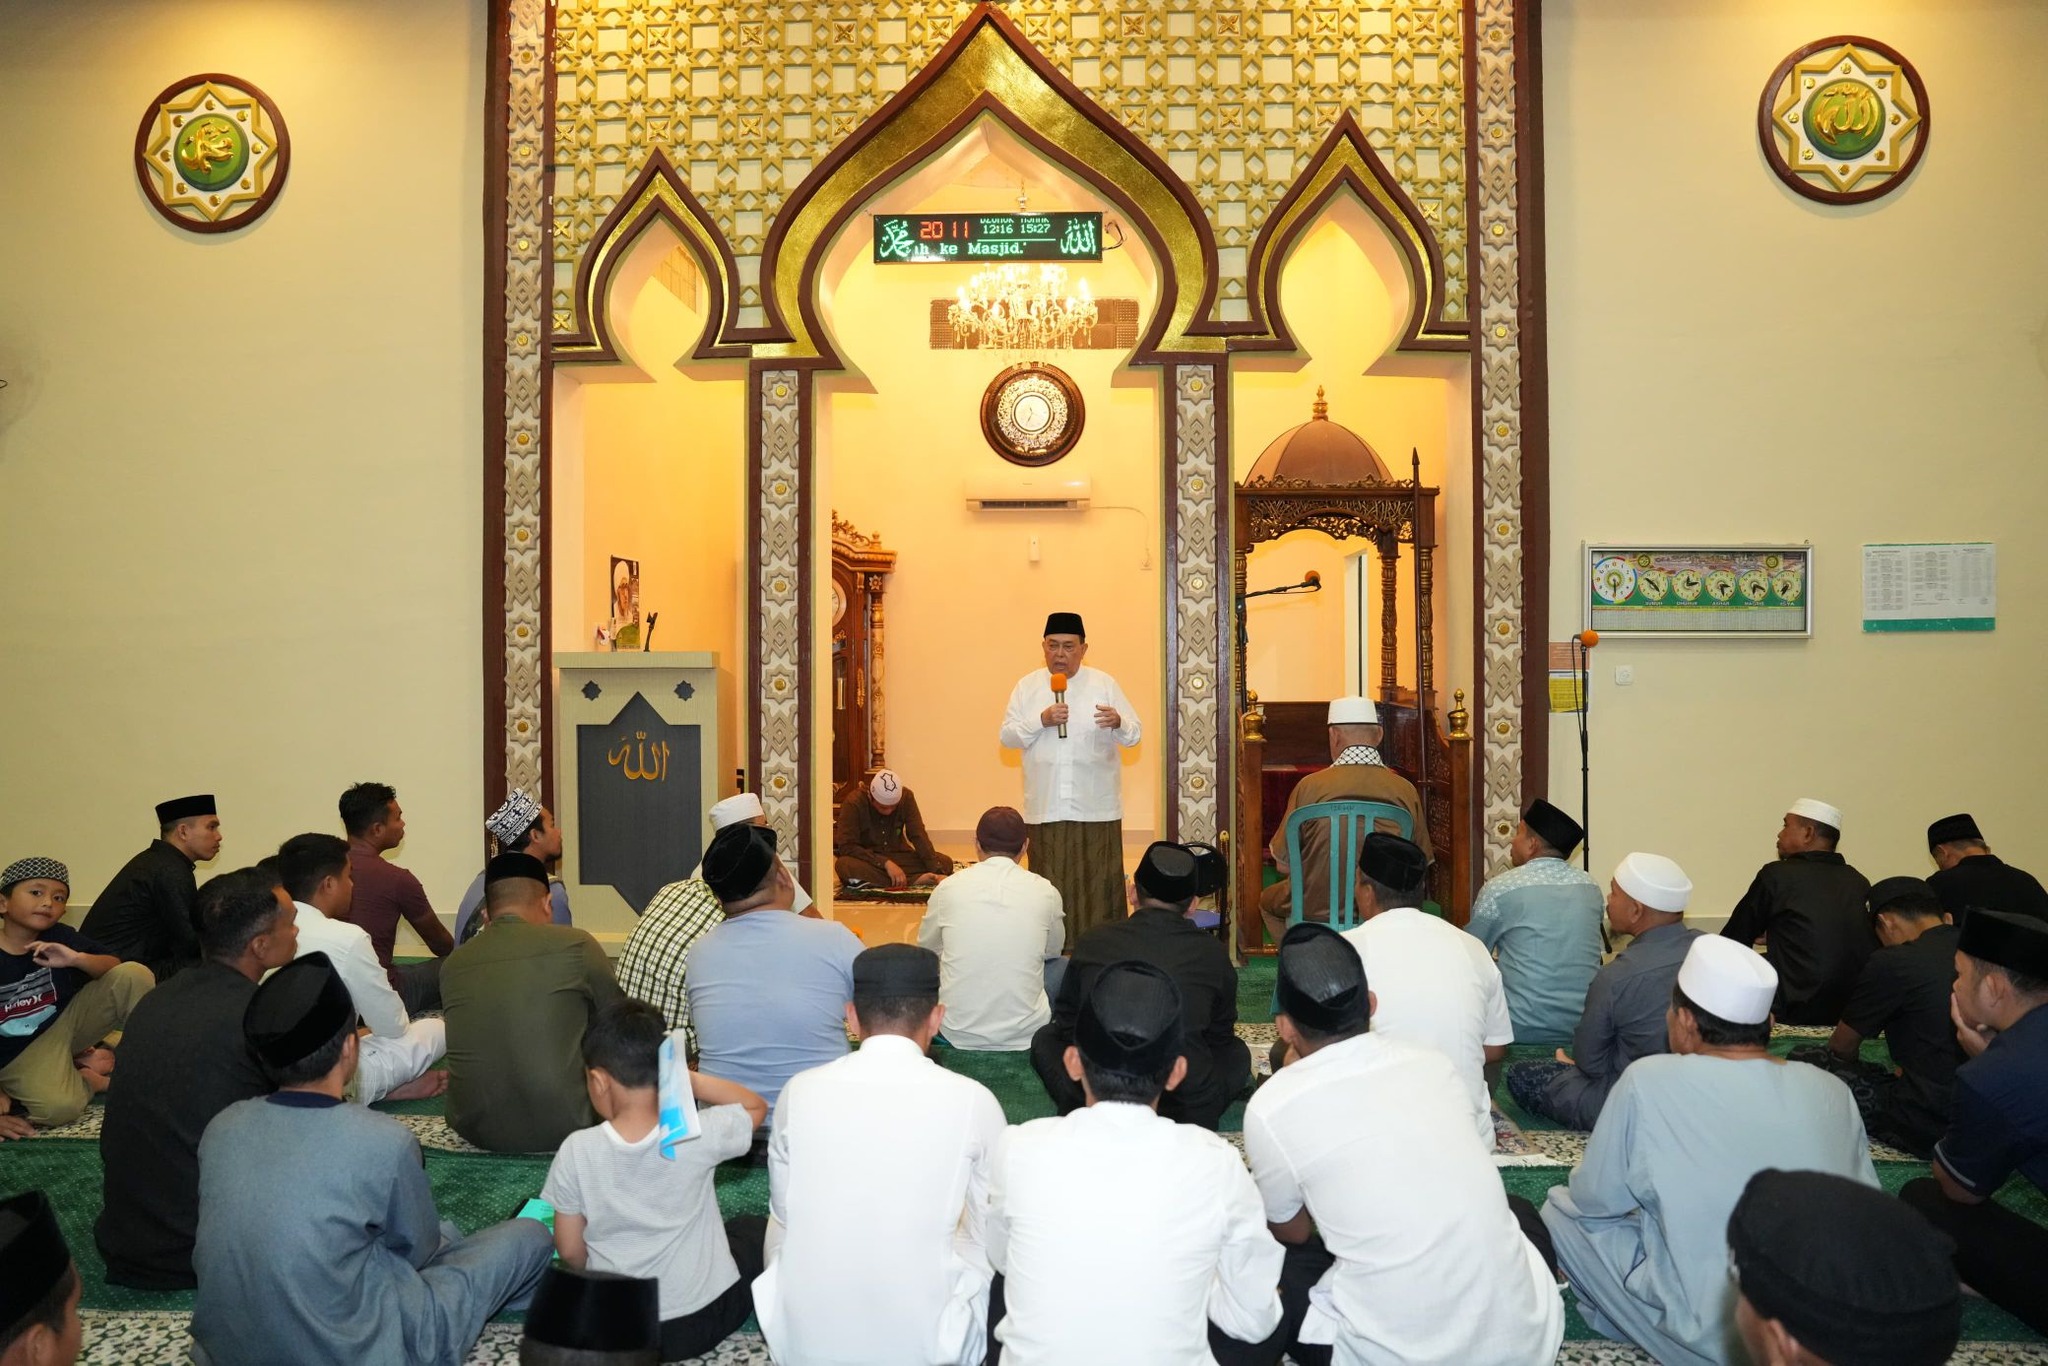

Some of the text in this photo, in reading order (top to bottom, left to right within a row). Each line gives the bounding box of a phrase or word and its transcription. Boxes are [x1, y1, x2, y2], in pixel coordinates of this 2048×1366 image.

[983, 223, 1050, 234] 12:16 15:27
[939, 242, 958, 255] ke
[967, 241, 1024, 257] Masjid.
